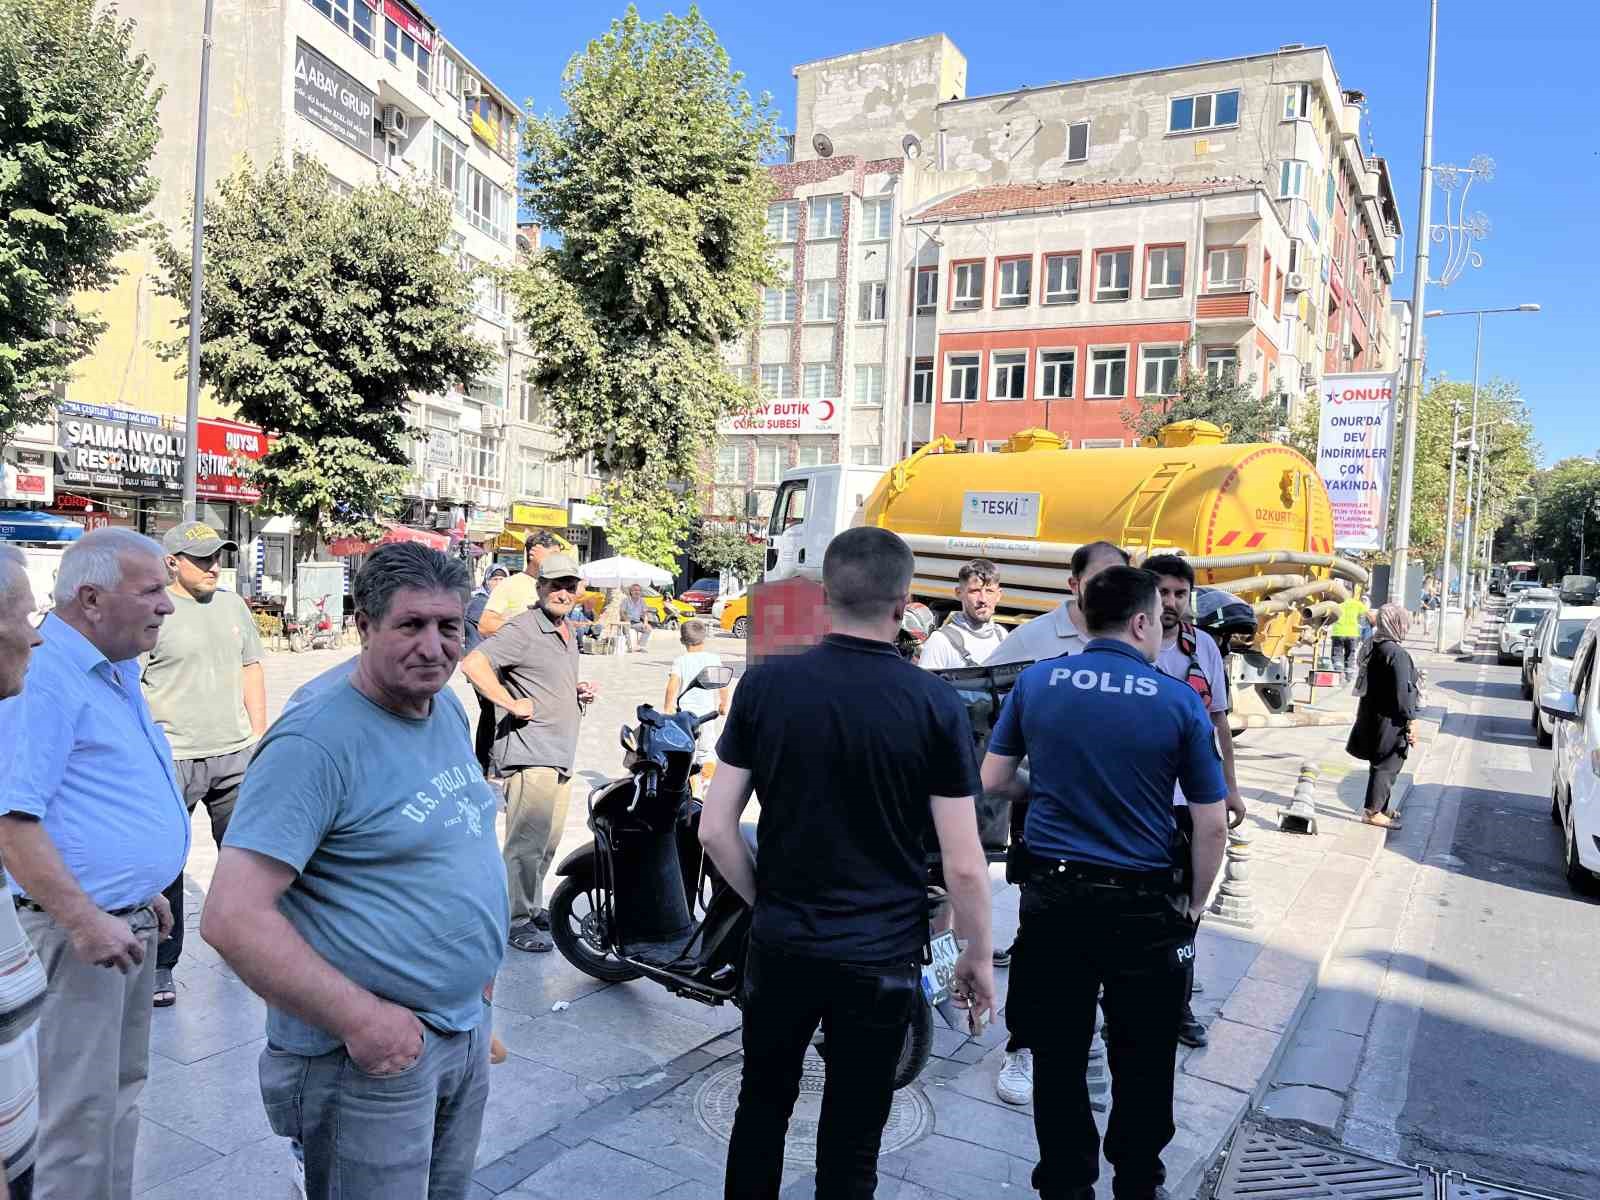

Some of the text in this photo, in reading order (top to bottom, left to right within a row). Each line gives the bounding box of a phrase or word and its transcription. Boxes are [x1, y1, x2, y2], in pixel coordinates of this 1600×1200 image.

[308, 67, 338, 99] ABAY
[341, 89, 370, 119] GRUP
[1342, 388, 1392, 401] ONUR
[1331, 416, 1382, 426] ONUR'DA
[66, 421, 186, 458] SAMANYOLU
[1343, 432, 1366, 443] DEV
[1321, 446, 1387, 459] İNDİRİMLER
[76, 448, 180, 477] RESTAURANT
[1340, 464, 1365, 477] ÇOK
[1325, 479, 1377, 490] YAKINDA
[981, 497, 1018, 516] TESKİ
[401, 791, 439, 824] U.S.
[430, 766, 468, 799] POLO
